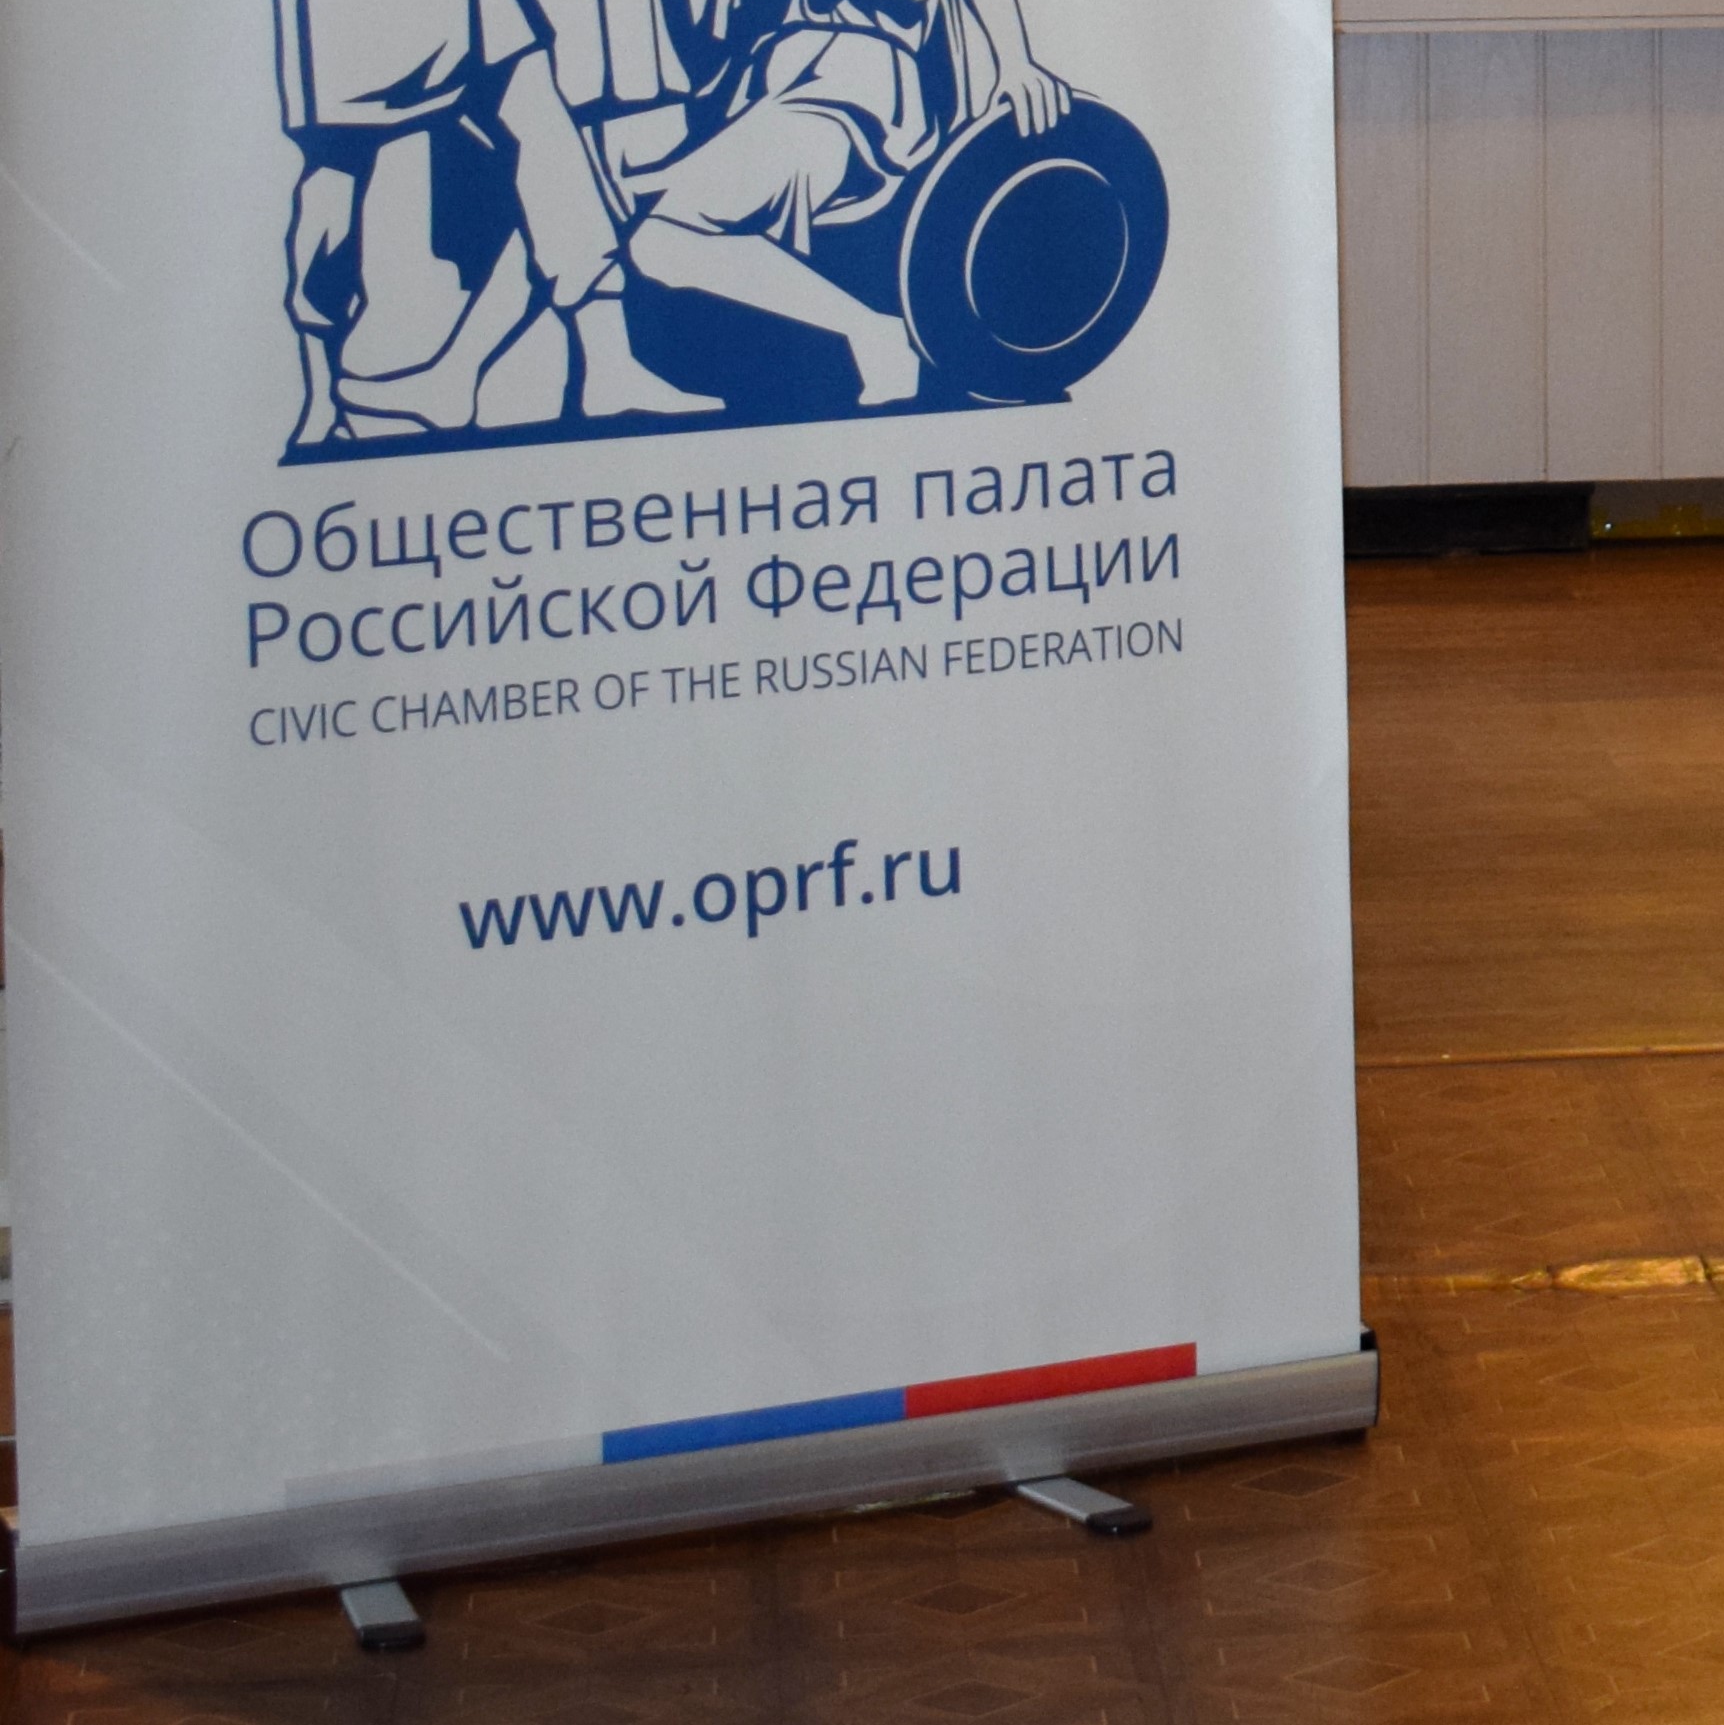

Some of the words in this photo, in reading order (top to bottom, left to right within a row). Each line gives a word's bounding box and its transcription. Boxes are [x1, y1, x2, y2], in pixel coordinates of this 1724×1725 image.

[242, 476, 877, 579] Общественная
[915, 450, 1176, 519] палата
[248, 558, 716, 668] Российской
[747, 533, 1179, 624] Федерации
[250, 700, 356, 746] CIVIC
[372, 679, 580, 733] CHAMBER
[595, 671, 649, 710] OF
[661, 662, 740, 703] THE
[756, 644, 927, 695] RUSSIAN
[945, 618, 1182, 676] FEDERATION
[459, 839, 960, 950] www.oprf.ru
